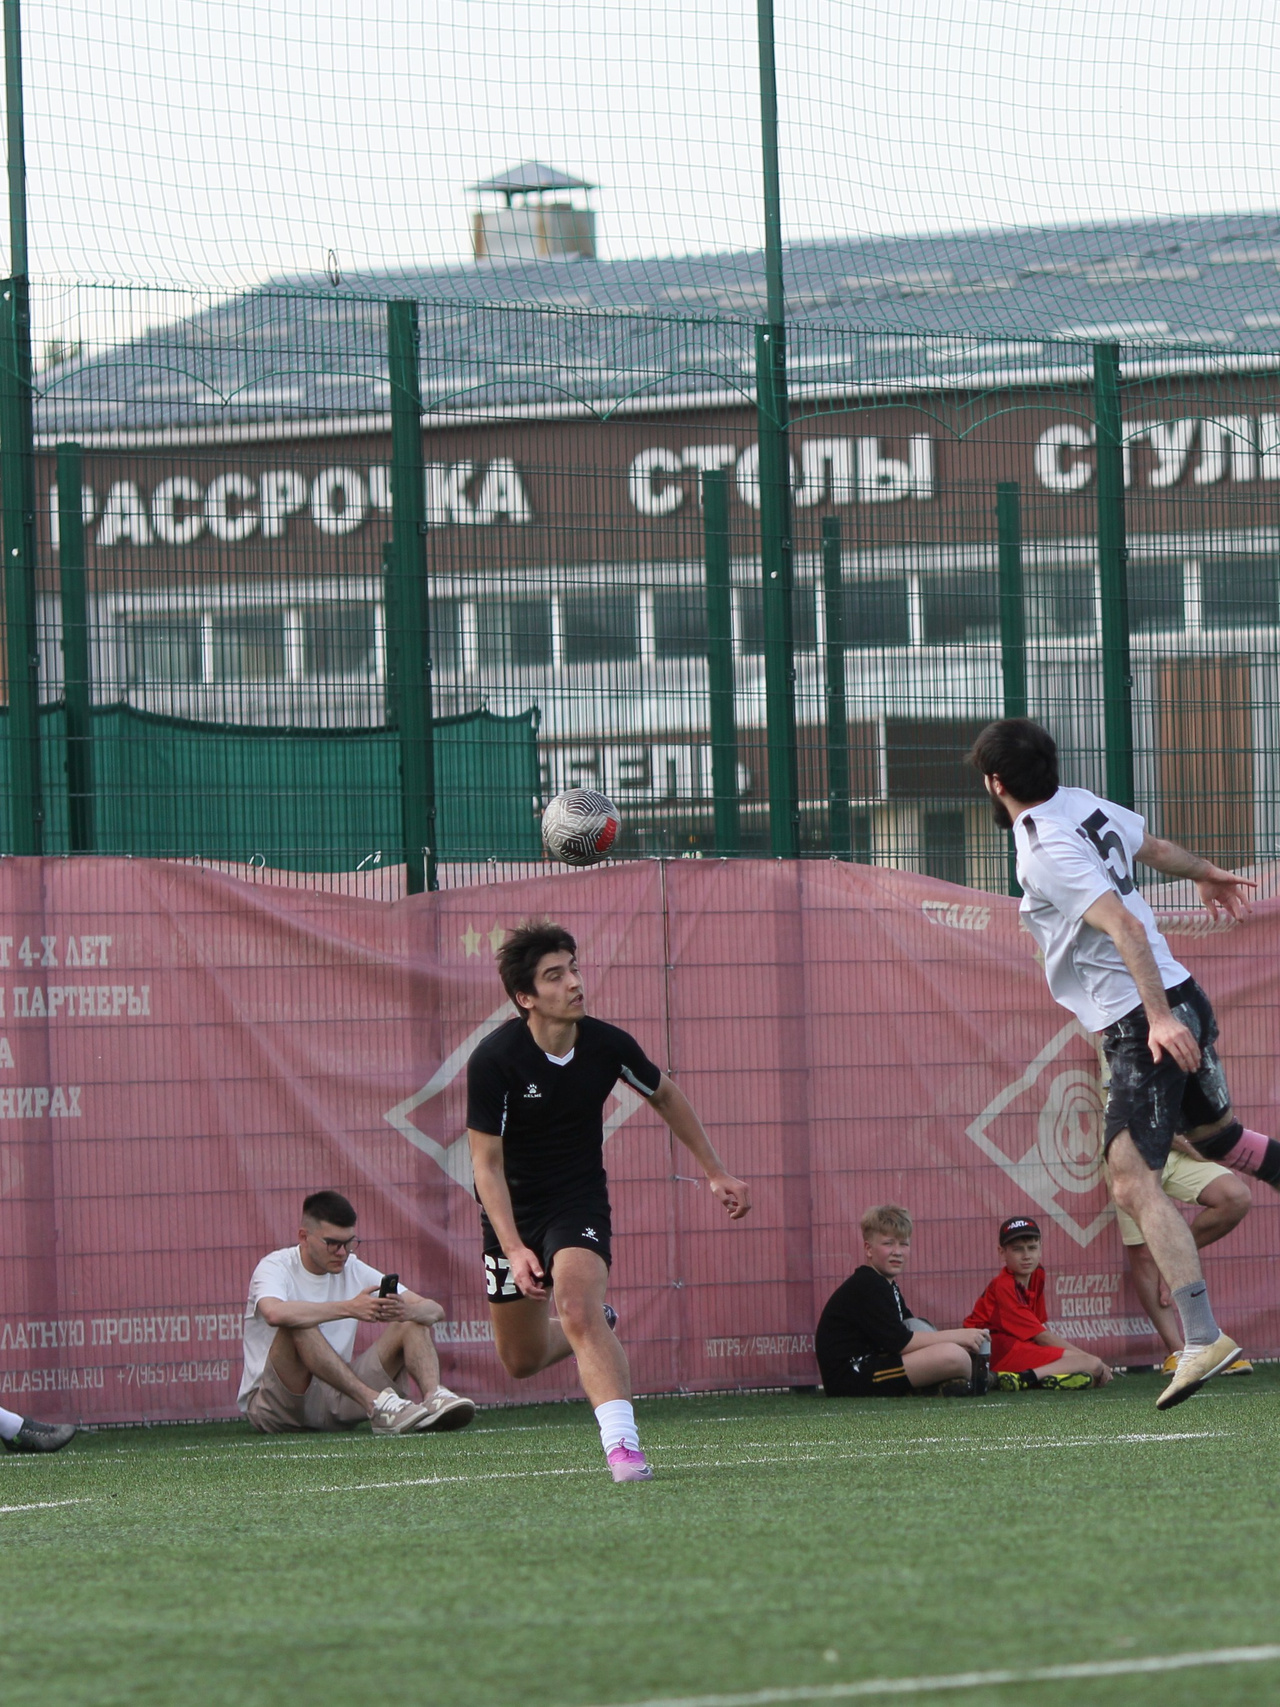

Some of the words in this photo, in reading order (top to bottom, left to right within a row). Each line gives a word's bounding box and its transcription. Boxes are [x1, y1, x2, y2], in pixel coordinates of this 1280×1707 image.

[540, 744, 752, 803] БЕЛЬ
[921, 900, 991, 930] СТАНЬ
[65, 935, 112, 966] ЛЕТ
[13, 985, 150, 1017] ПАРТНЕРЫ
[1056, 1274, 1121, 1295] СПАРТАК
[1061, 1297, 1112, 1317] ЮНИОР
[91, 1316, 191, 1346] ПРОБНУЮ
[433, 1321, 496, 1343] ЖЕЛЕЗ
[0, 1366, 104, 1393] ALASHIHA.RU
